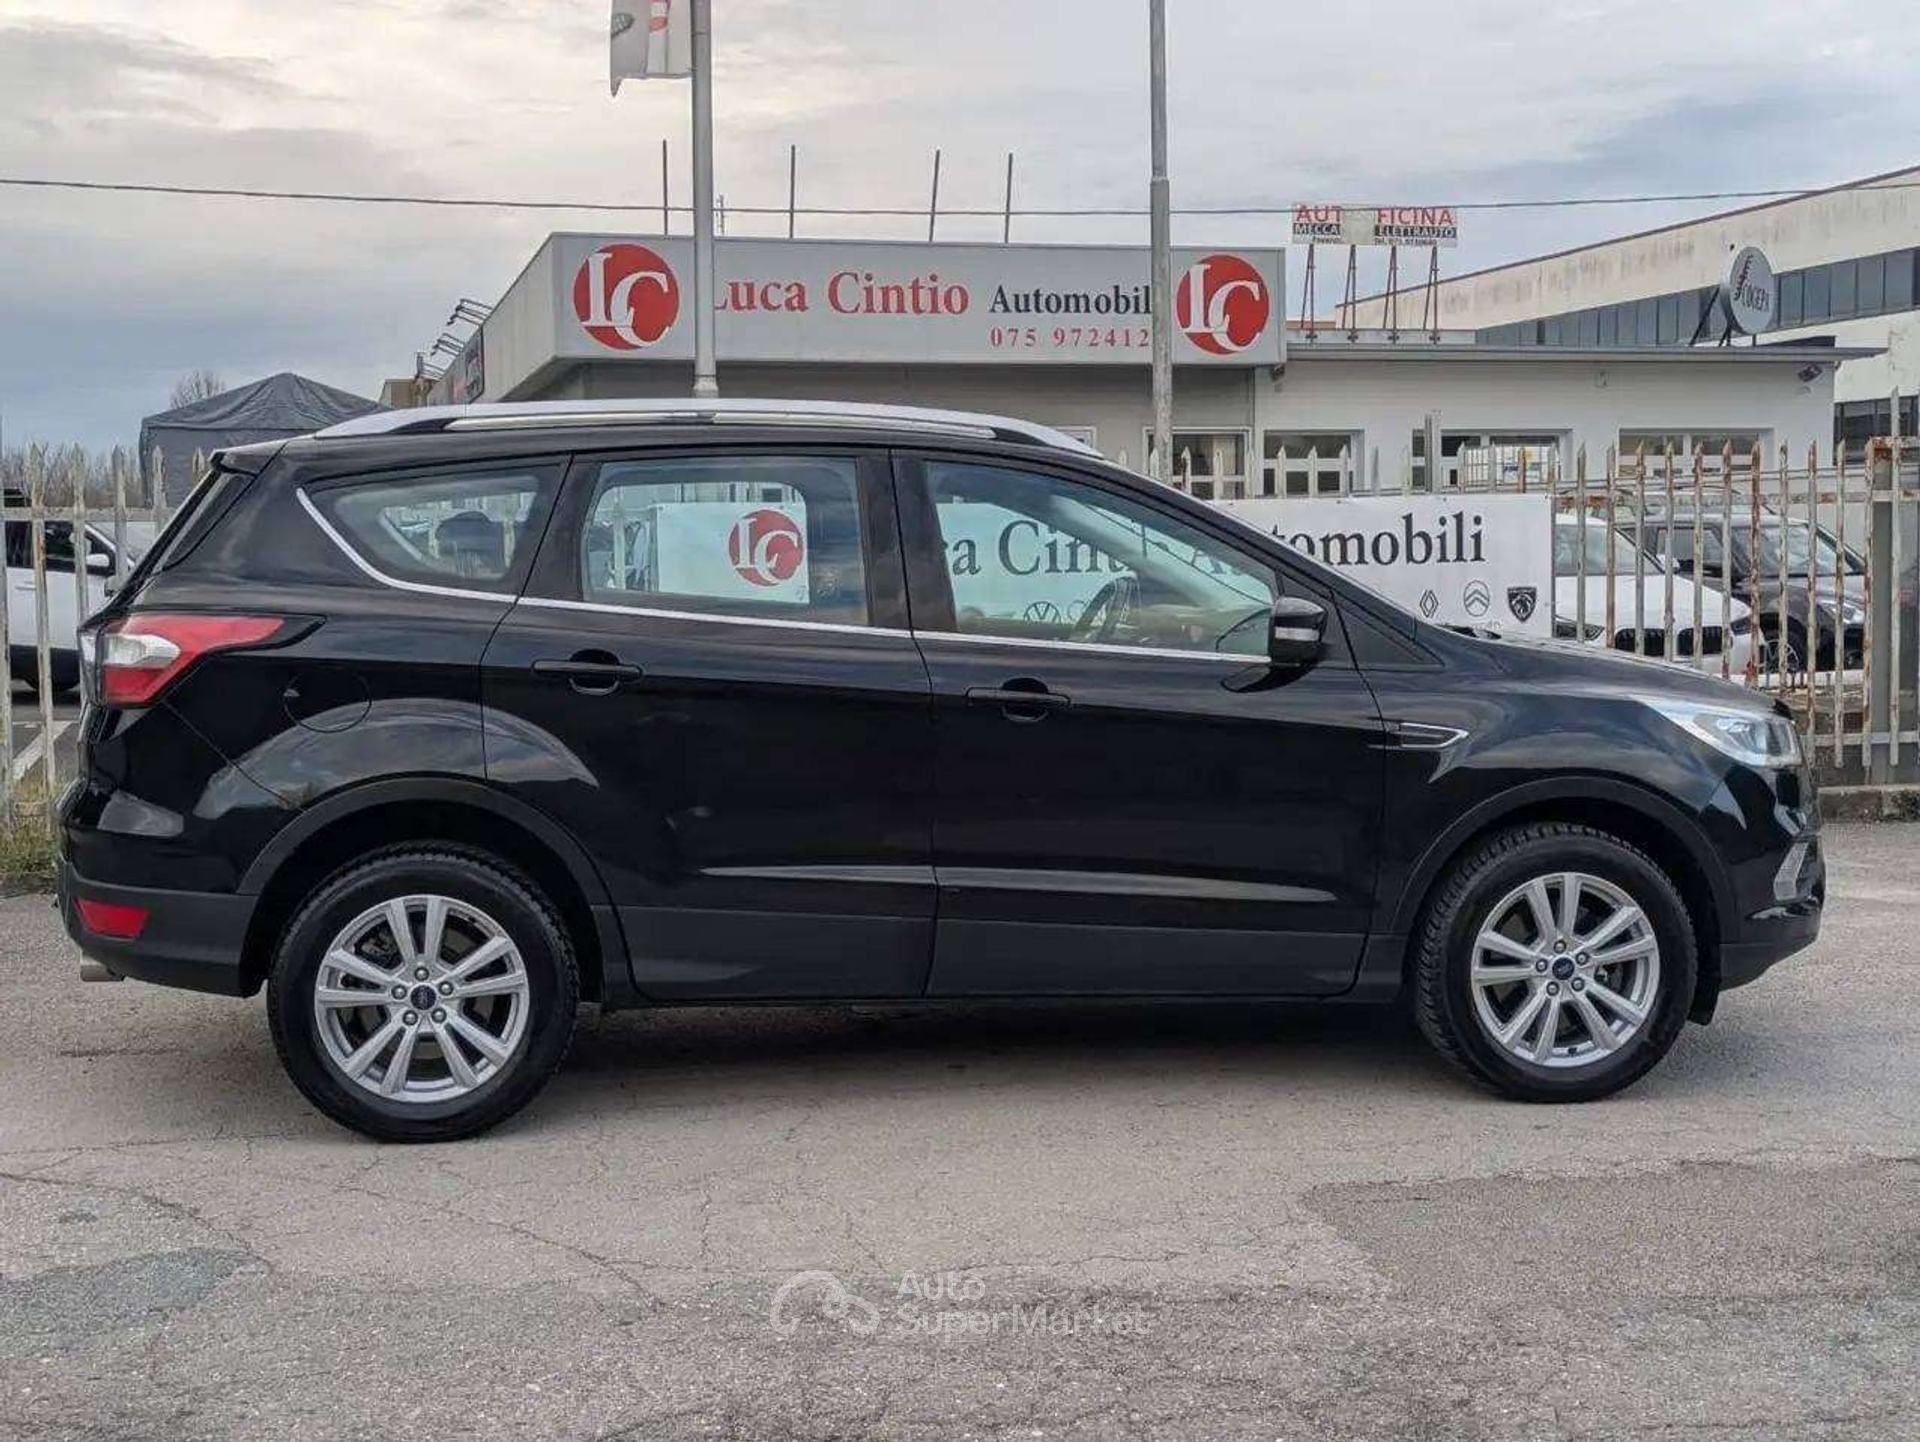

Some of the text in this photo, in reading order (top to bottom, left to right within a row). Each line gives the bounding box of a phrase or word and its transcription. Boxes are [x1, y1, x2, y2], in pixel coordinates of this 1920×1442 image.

[827, 270, 970, 315] Cintio
[987, 283, 1152, 315] Automobil
[989, 327, 1150, 348] 075 972412
